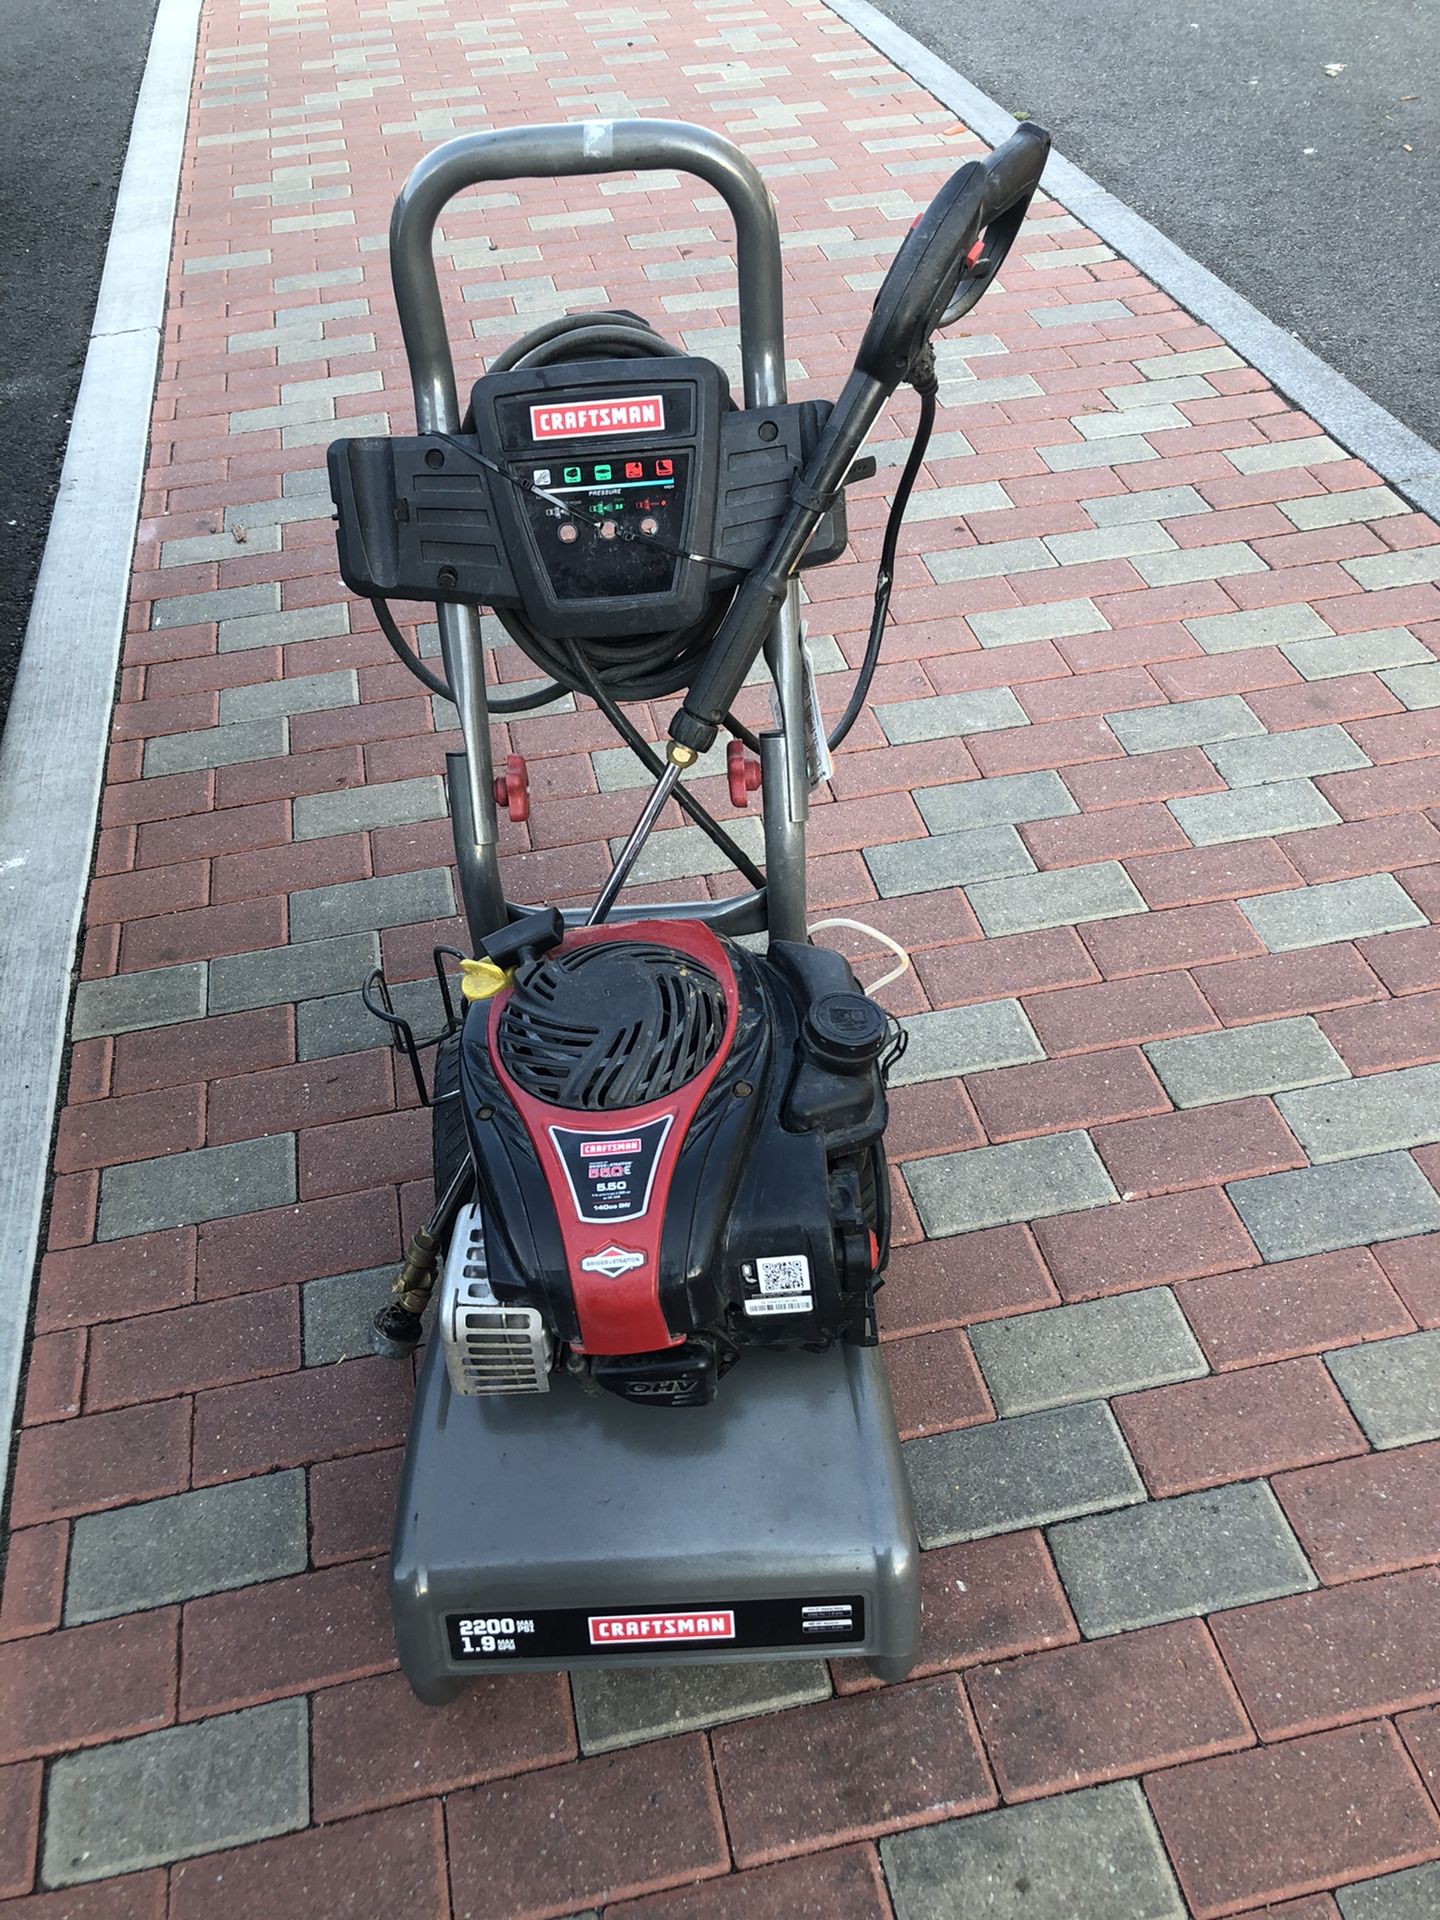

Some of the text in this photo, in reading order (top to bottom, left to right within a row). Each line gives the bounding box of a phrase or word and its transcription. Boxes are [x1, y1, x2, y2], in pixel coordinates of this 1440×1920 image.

[540, 404, 655, 431] CRAFTSMAN
[588, 488, 622, 496] PRESSURE
[584, 1141, 638, 1153] CRAFTSMAN
[459, 1617, 534, 1636] 2200 MAX
[517, 1625, 535, 1633] PSI
[598, 1617, 725, 1637] CRAFTSMAN
[461, 1635, 496, 1653] 1.9
